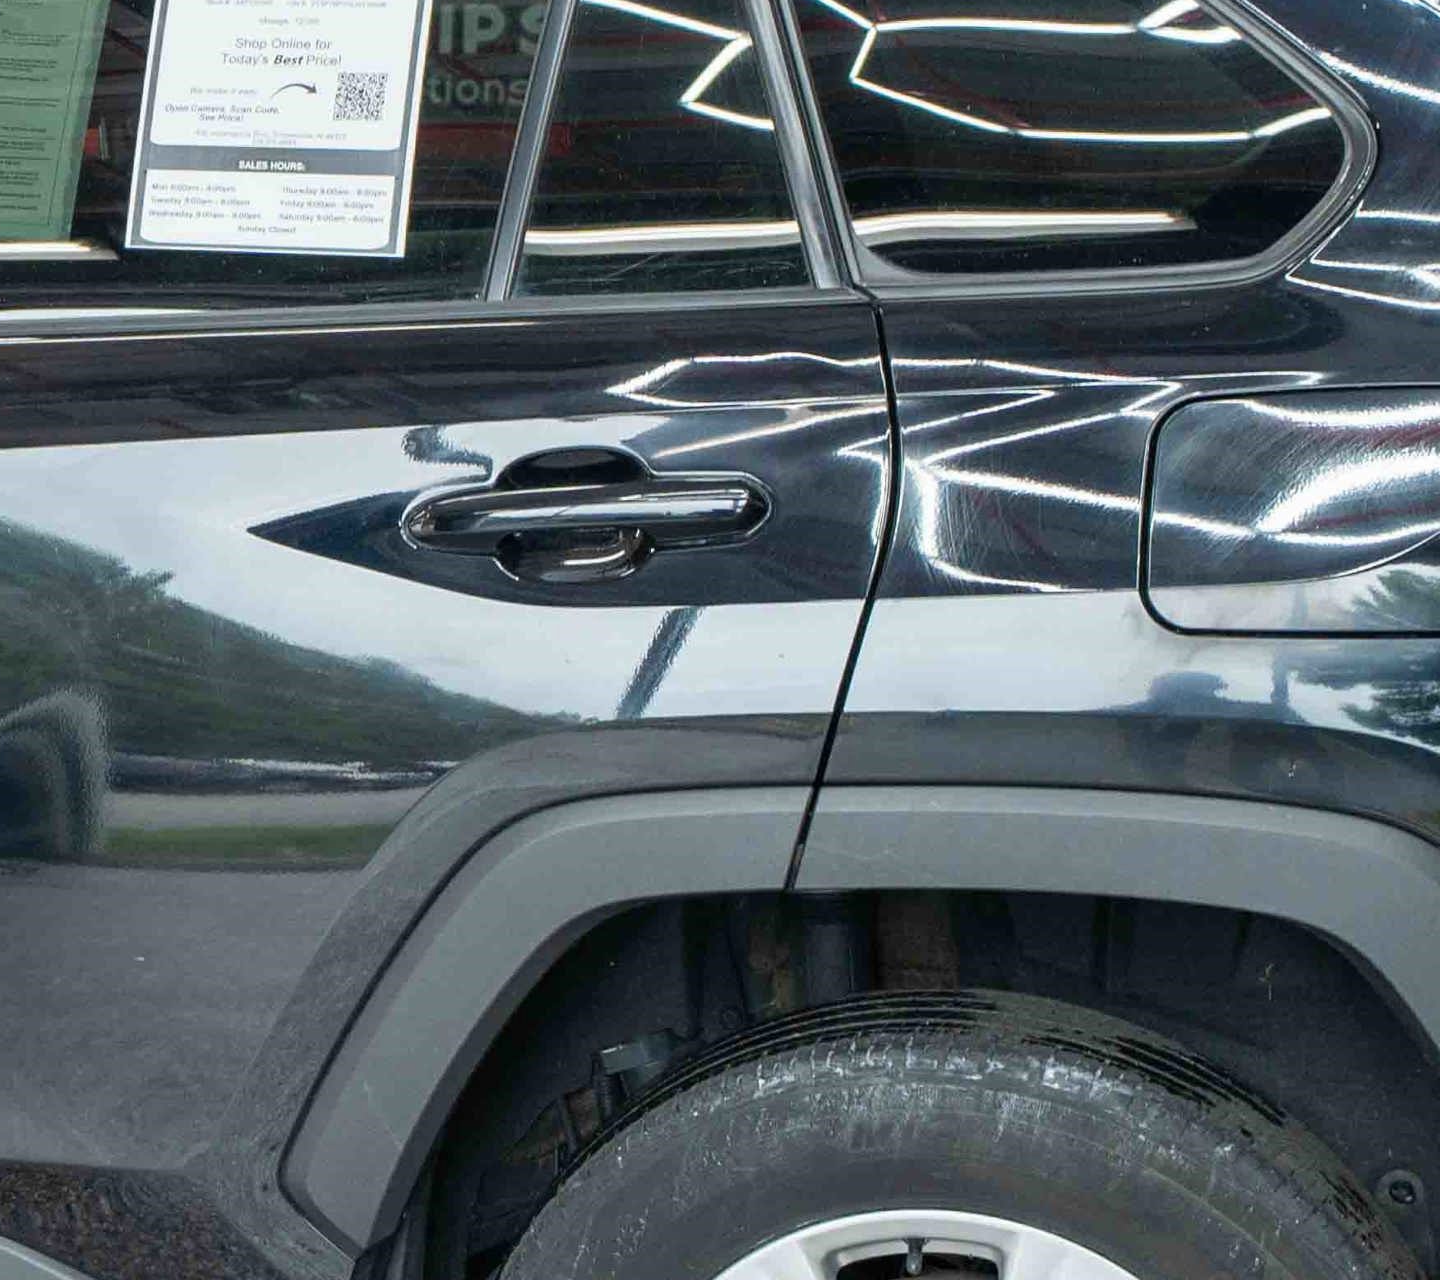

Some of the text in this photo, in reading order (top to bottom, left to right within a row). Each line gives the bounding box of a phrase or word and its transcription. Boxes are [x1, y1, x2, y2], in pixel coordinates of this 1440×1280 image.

[235, 38, 332, 52] Shop Online for
[222, 53, 342, 66] Today's Best Price!
[239, 160, 268, 170] SALES
